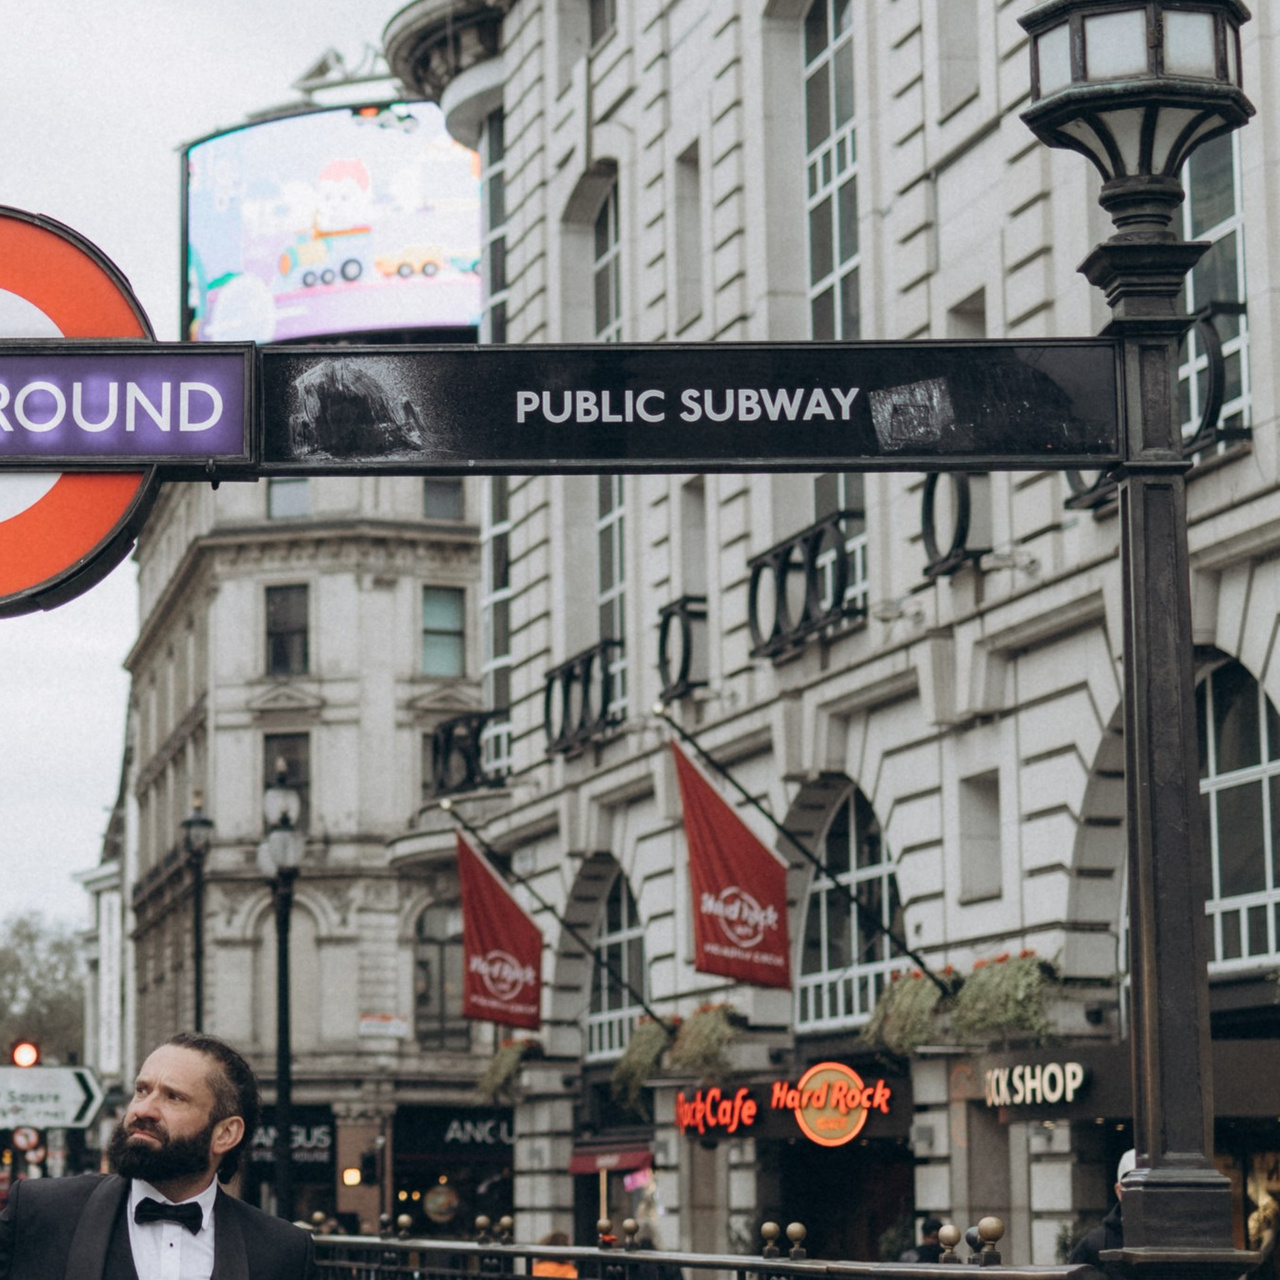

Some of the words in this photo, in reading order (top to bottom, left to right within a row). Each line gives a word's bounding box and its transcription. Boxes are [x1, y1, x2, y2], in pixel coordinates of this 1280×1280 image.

[517, 390, 665, 424] PUBLIC
[679, 387, 860, 422] SUBWAY
[770, 1080, 829, 1110] Hard
[830, 1078, 891, 1115] Rock
[1012, 1061, 1084, 1104] SHOP
